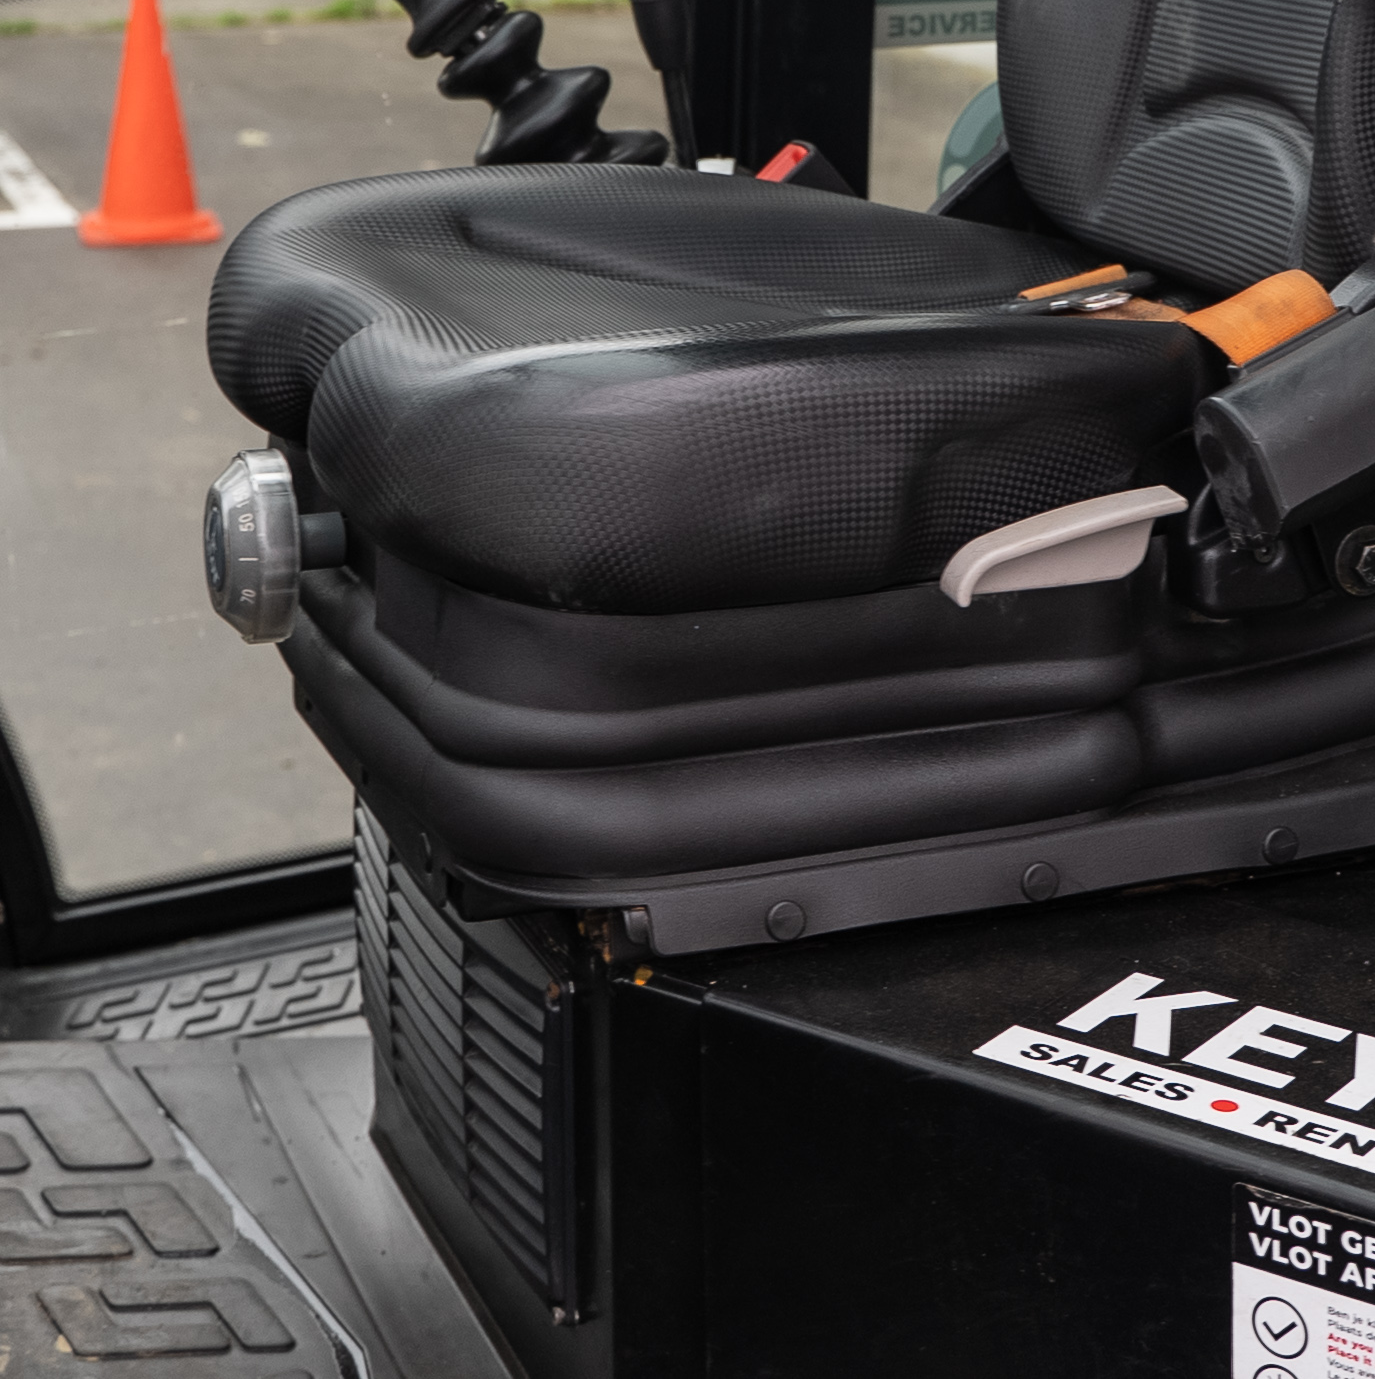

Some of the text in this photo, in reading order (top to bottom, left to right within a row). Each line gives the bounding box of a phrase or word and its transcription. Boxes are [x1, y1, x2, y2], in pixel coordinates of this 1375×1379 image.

[237, 512, 256, 532] 50
[1019, 1042, 1196, 1102] SALES
[1247, 1201, 1333, 1245] VLOT
[1247, 1231, 1333, 1276] VLOT
[1327, 1333, 1348, 1345] Are
[1351, 1341, 1374, 1353] you
[1327, 1345, 1360, 1362] Place
